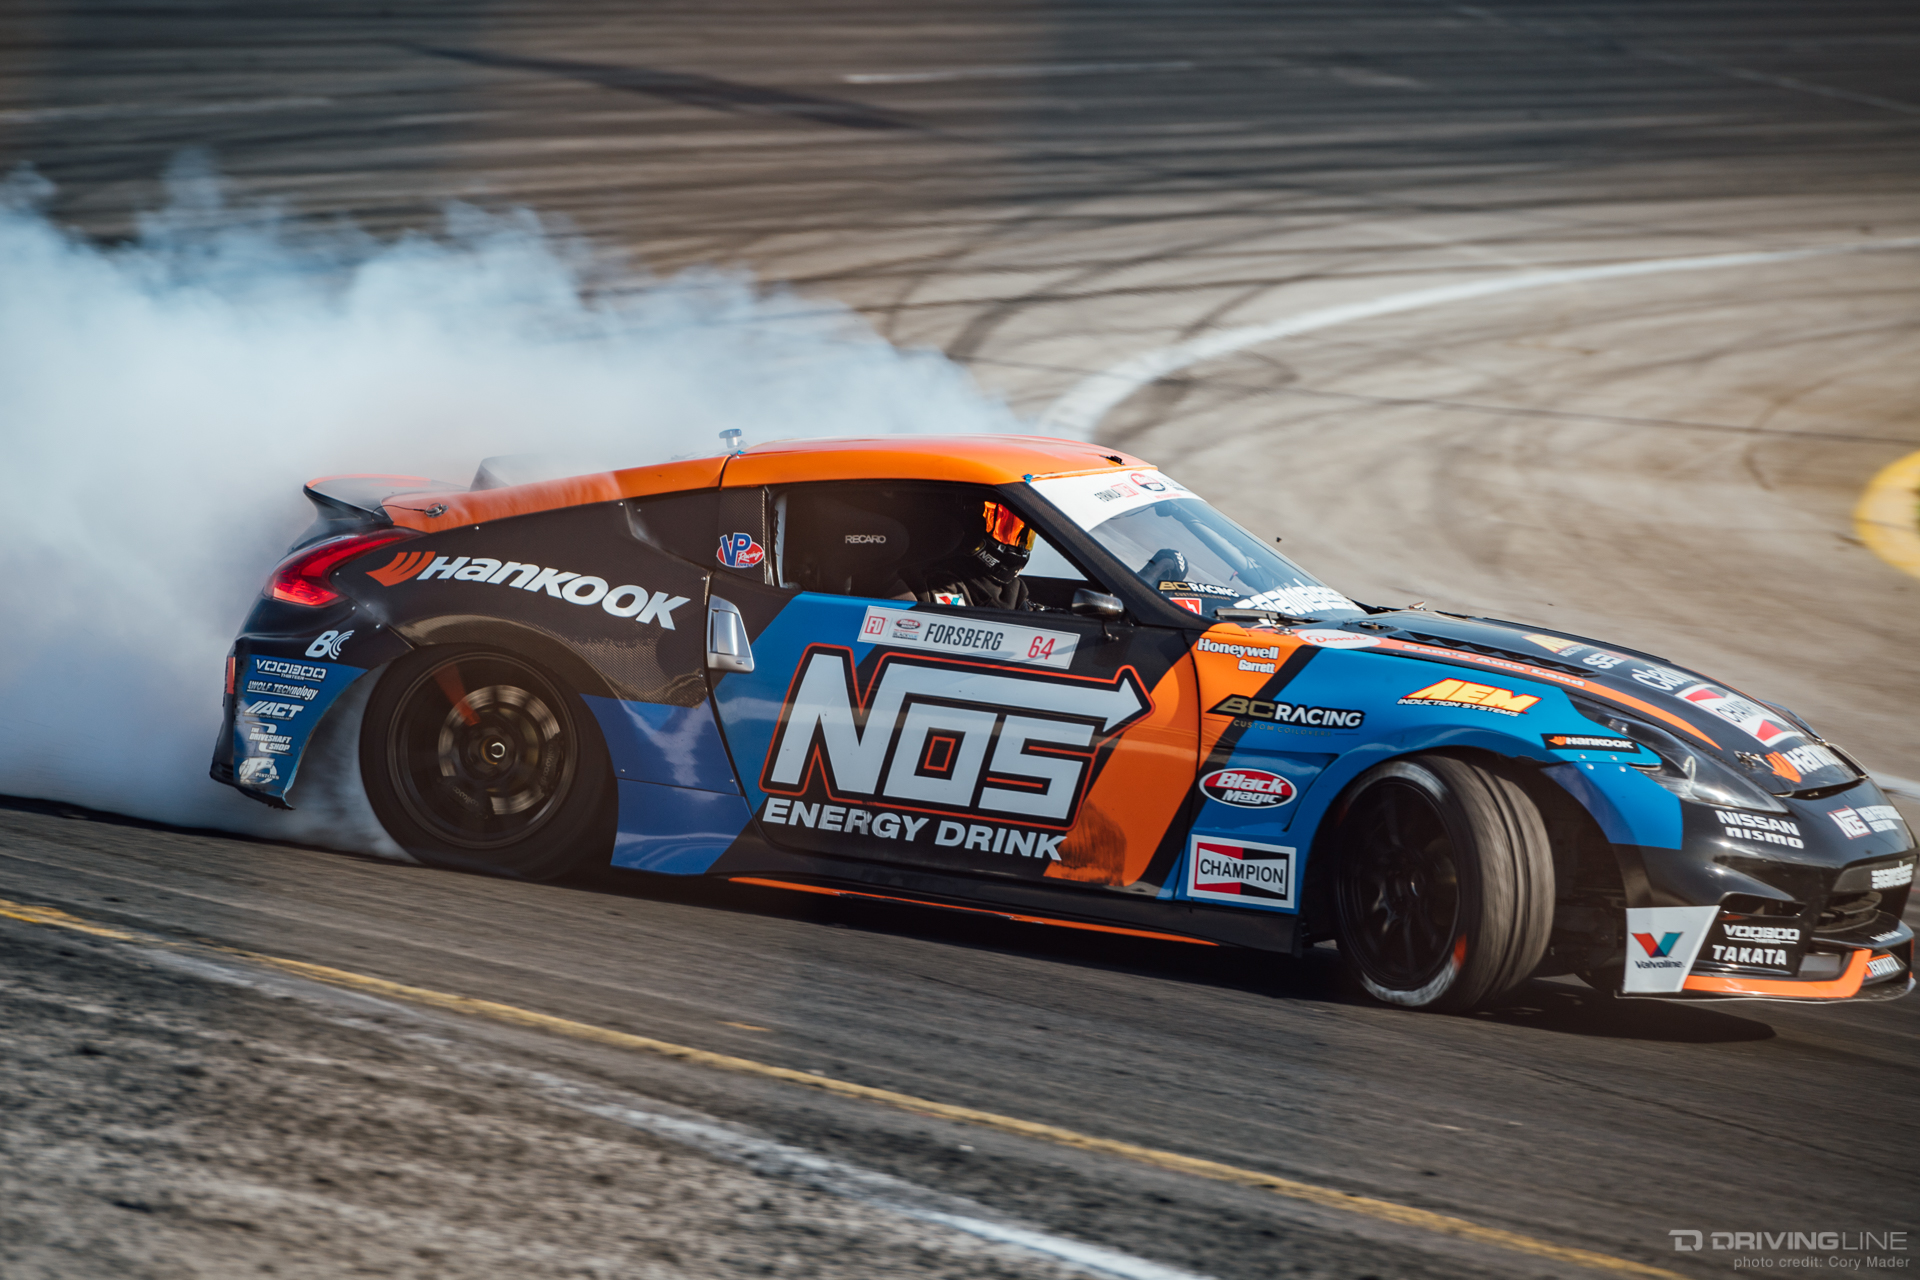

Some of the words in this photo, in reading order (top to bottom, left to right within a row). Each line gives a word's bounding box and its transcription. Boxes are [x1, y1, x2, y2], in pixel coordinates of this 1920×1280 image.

[719, 532, 752, 567] VP
[845, 535, 886, 544] RECARO
[979, 550, 1000, 567] NOS
[924, 622, 1004, 651] FORSBERG
[1306, 633, 1368, 645] Donut
[1027, 635, 1056, 660] 64
[1197, 638, 1279, 660] Honeywell
[1238, 658, 1276, 674] Garrett
[1403, 644, 1471, 660] Sam's
[1476, 657, 1526, 671] Auto
[1531, 668, 1586, 687] Land
[248, 680, 273, 692] WOLF
[1403, 678, 1543, 713] AEM
[1397, 698, 1462, 708] INDUCTION
[1463, 702, 1520, 717] SYSTEMS
[770, 652, 1143, 820] NOS
[1233, 720, 1275, 731] CUSTOM
[249, 733, 292, 744] DRIVESHAFT
[269, 743, 290, 751] SHOP
[1216, 772, 1287, 794] Black
[1222, 789, 1282, 805] Magic
[762, 798, 936, 842] ENERGY
[935, 819, 1068, 861] DRINK
[1715, 810, 1801, 836] NISSAN
[1725, 826, 1805, 849] nismo
[1200, 858, 1284, 884] CHAMPION
[1635, 959, 1685, 970] Valvoline
[1712, 945, 1787, 966] TAKATA
